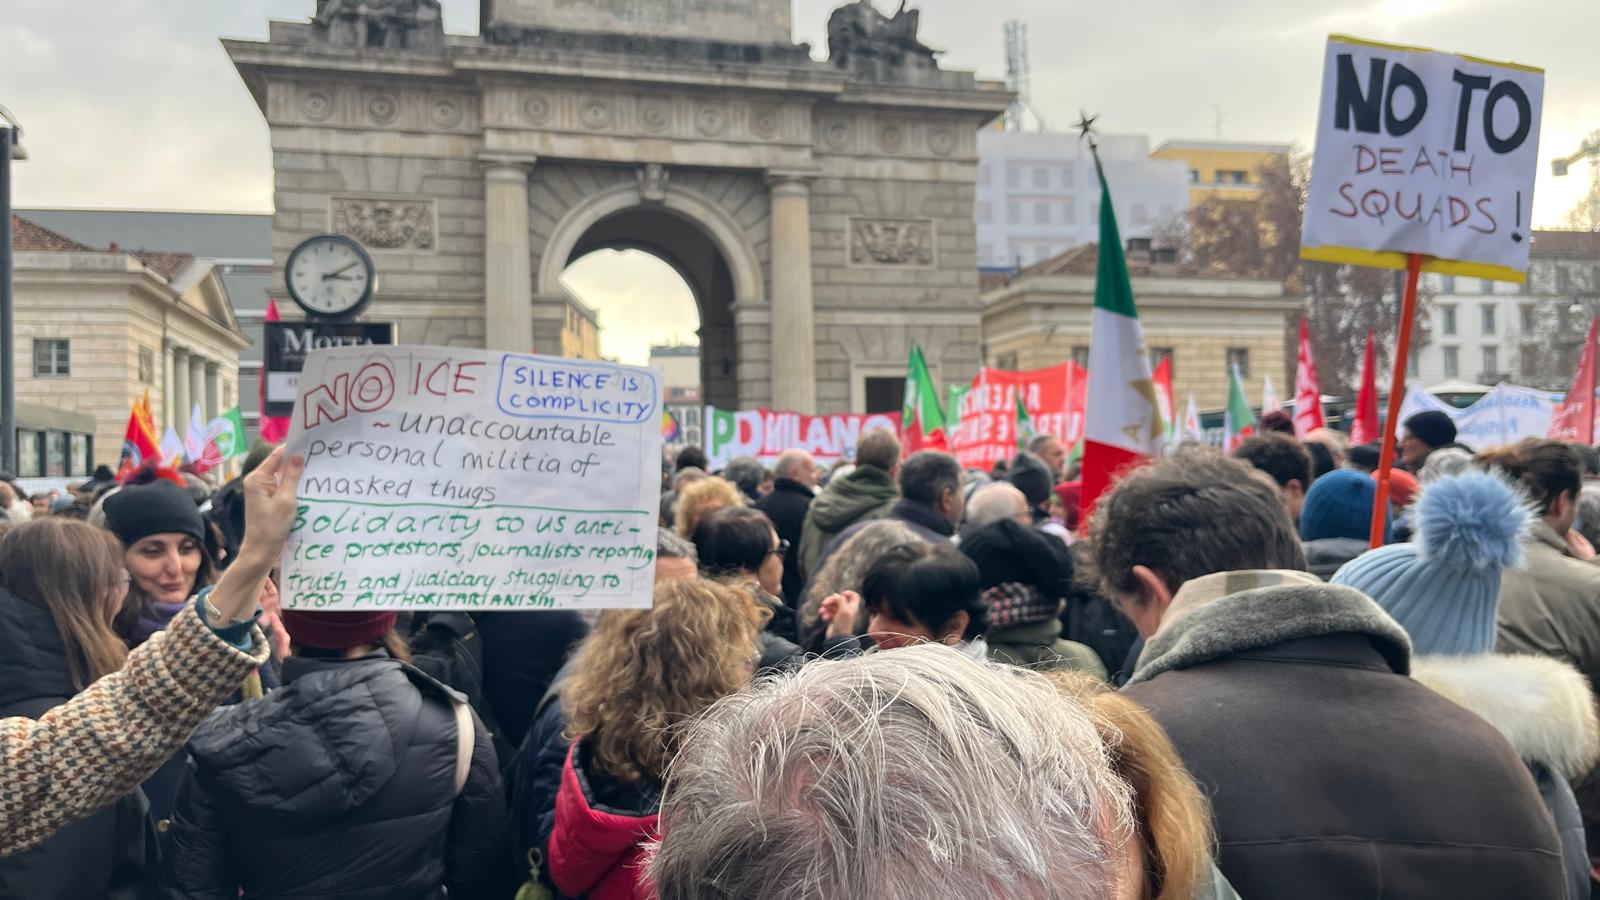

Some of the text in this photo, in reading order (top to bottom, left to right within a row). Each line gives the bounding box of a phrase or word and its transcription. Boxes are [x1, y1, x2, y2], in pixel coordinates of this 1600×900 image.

[1333, 54, 1532, 154] NO TO
[1353, 144, 1475, 185] DEATH
[303, 361, 486, 430] NO ICE
[514, 366, 639, 392] SILENCE IS
[399, 411, 616, 447] unaccountable
[304, 440, 601, 478] personal militia of
[304, 475, 497, 508] masked thugs
[495, 516, 525, 533] to
[294, 540, 335, 560] ice
[468, 541, 583, 563] journalists
[587, 543, 655, 570] reporting
[288, 567, 620, 598] truth and judiciary stuggling to
[289, 592, 344, 608] STOP
